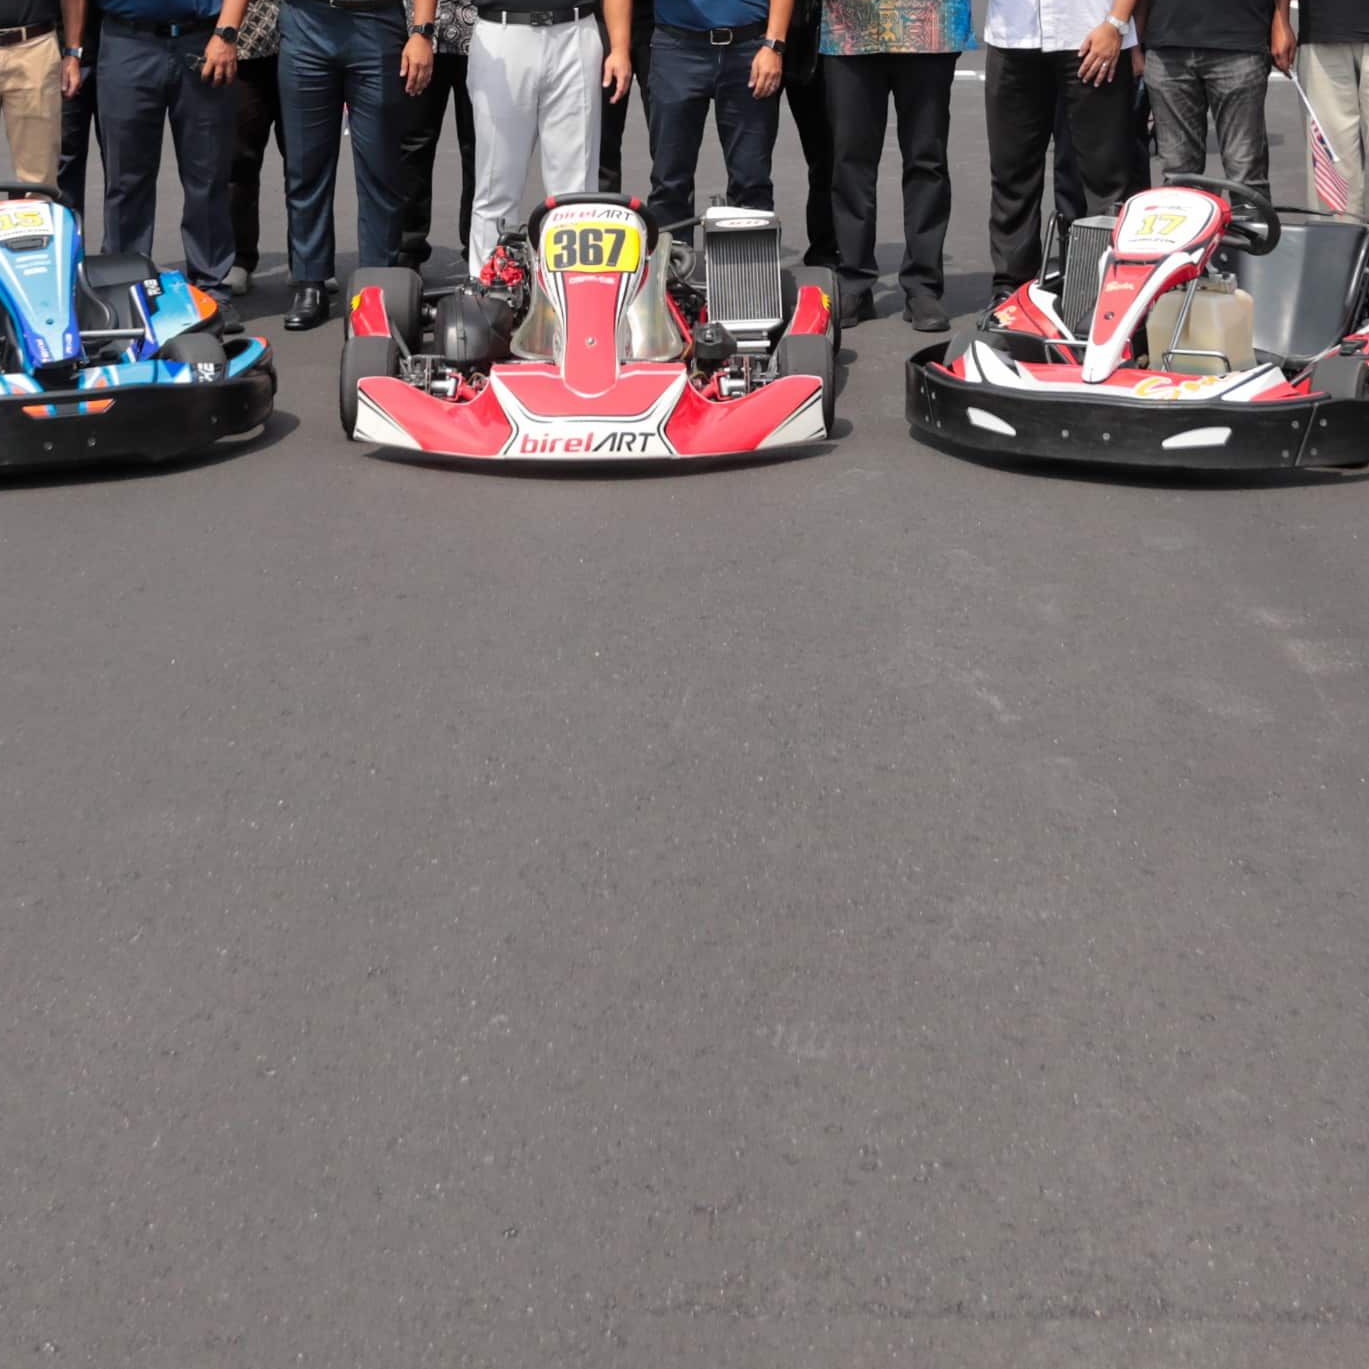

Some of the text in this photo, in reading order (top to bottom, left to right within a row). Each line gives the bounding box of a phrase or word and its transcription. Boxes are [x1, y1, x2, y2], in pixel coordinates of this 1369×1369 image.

[1135, 215, 1188, 235] 17
[553, 228, 626, 269] 367
[520, 432, 656, 453] birelART
